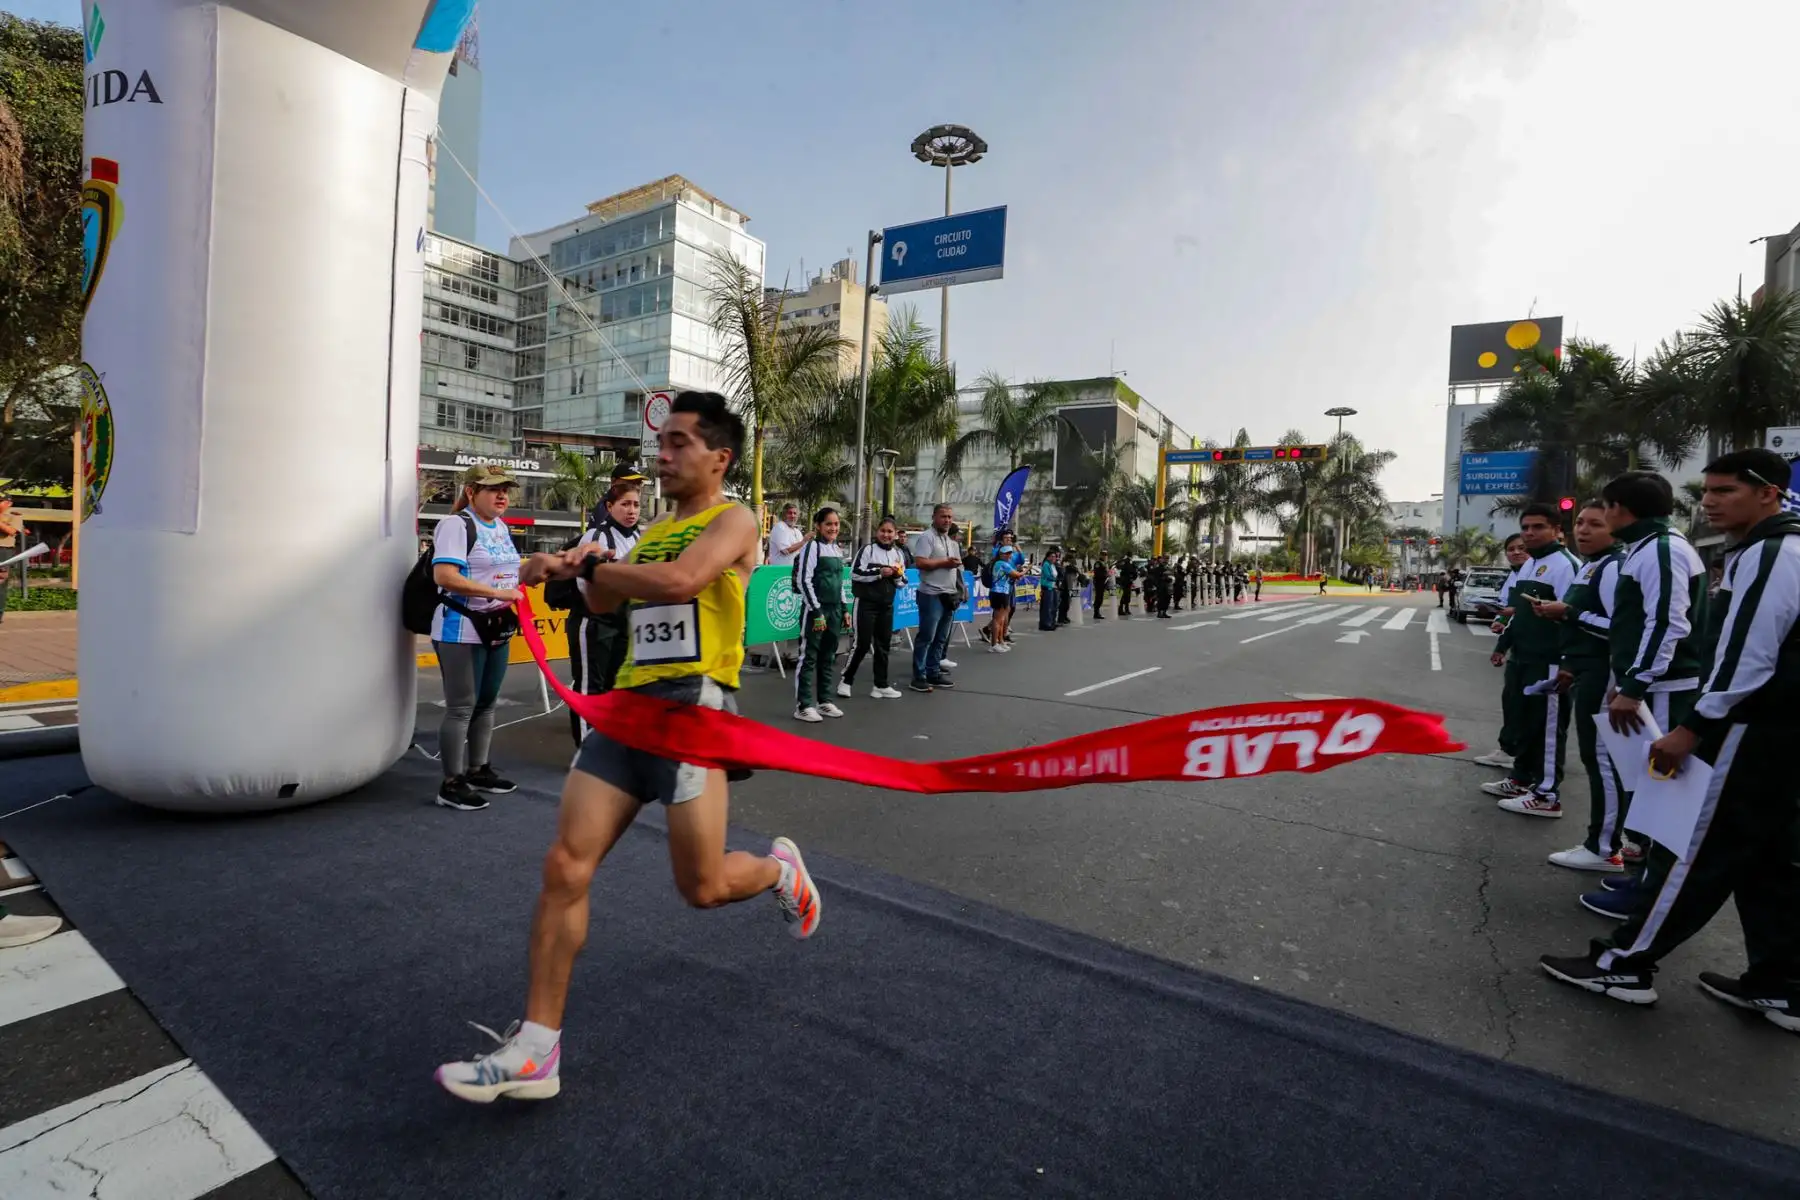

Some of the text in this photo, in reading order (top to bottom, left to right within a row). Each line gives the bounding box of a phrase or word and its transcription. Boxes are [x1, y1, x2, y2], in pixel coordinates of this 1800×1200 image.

[934, 229, 972, 246] CIRCUITO
[936, 244, 968, 259] CIUDAD
[455, 454, 540, 471] McDonald's
[1465, 456, 1489, 465] LIMA
[1465, 471, 1518, 480] SURQUILLO
[1465, 483, 1481, 491] VIA
[634, 620, 685, 645] 1331
[1188, 709, 1325, 733] NUTRITION
